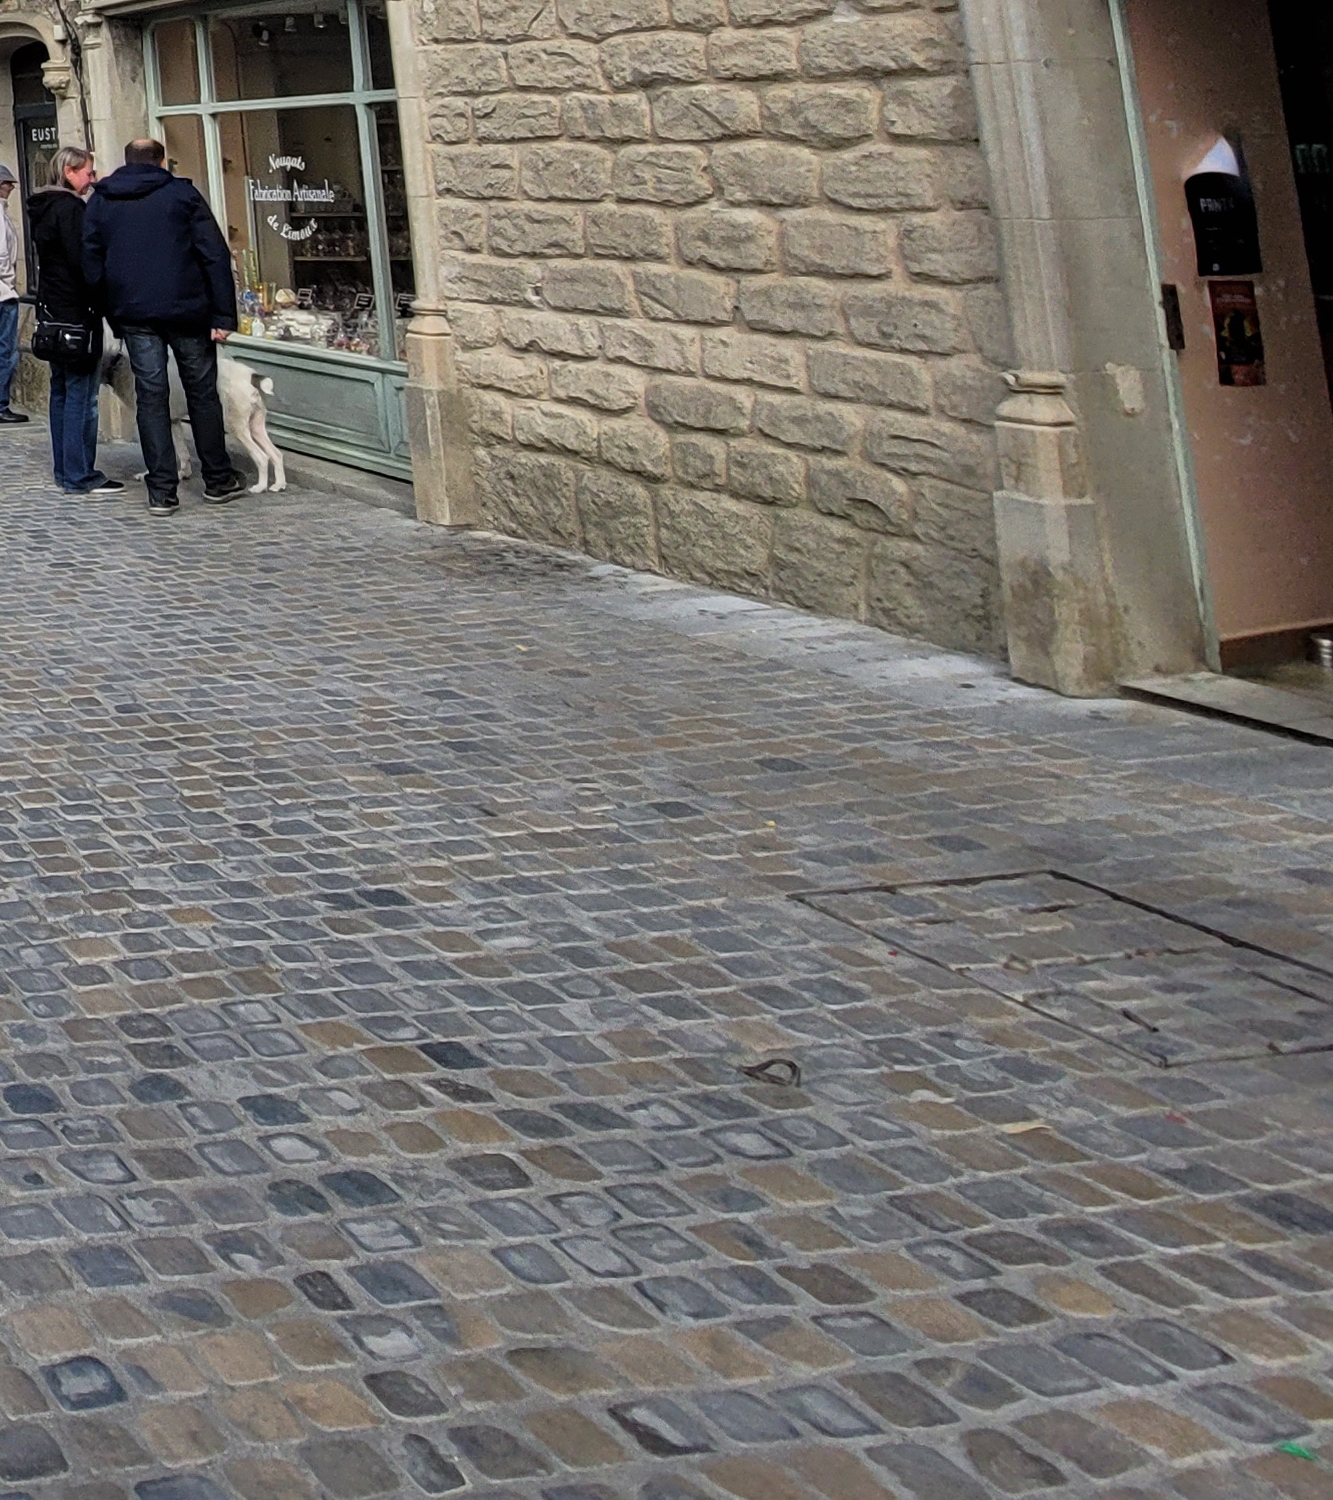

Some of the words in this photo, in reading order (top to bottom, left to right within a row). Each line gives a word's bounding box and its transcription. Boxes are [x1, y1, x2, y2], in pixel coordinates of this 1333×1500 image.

[268, 153, 306, 174] Nougats
[248, 179, 292, 202] Fabrication
[292, 179, 335, 203] Artisanale
[266, 214, 279, 231] de
[280, 218, 318, 241] Limoux
